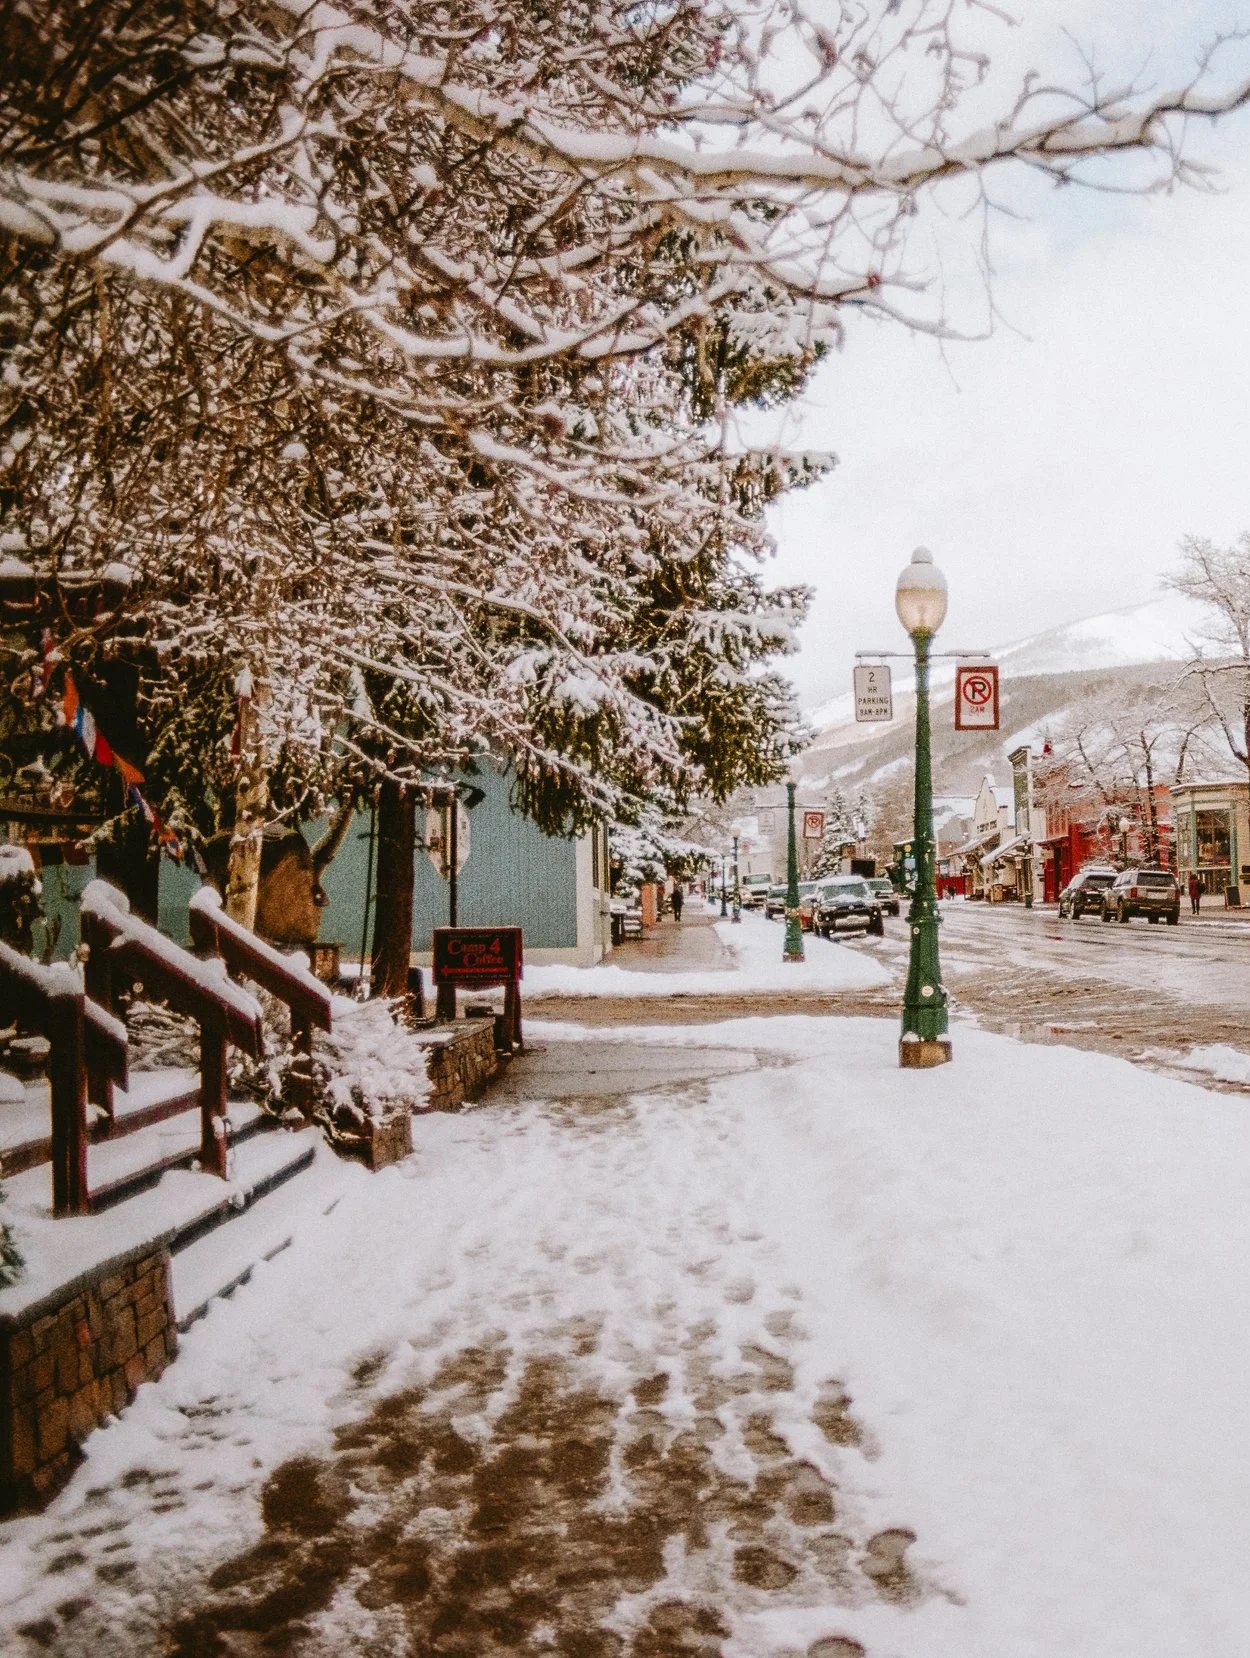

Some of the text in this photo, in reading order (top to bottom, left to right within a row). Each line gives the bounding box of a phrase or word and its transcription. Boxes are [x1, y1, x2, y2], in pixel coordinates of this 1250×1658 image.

[868, 671, 875, 683] 2
[867, 686, 878, 694] HR
[858, 697, 889, 705] PARKING
[447, 938, 501, 955] Camp 4
[463, 953, 504, 967] Coffee
